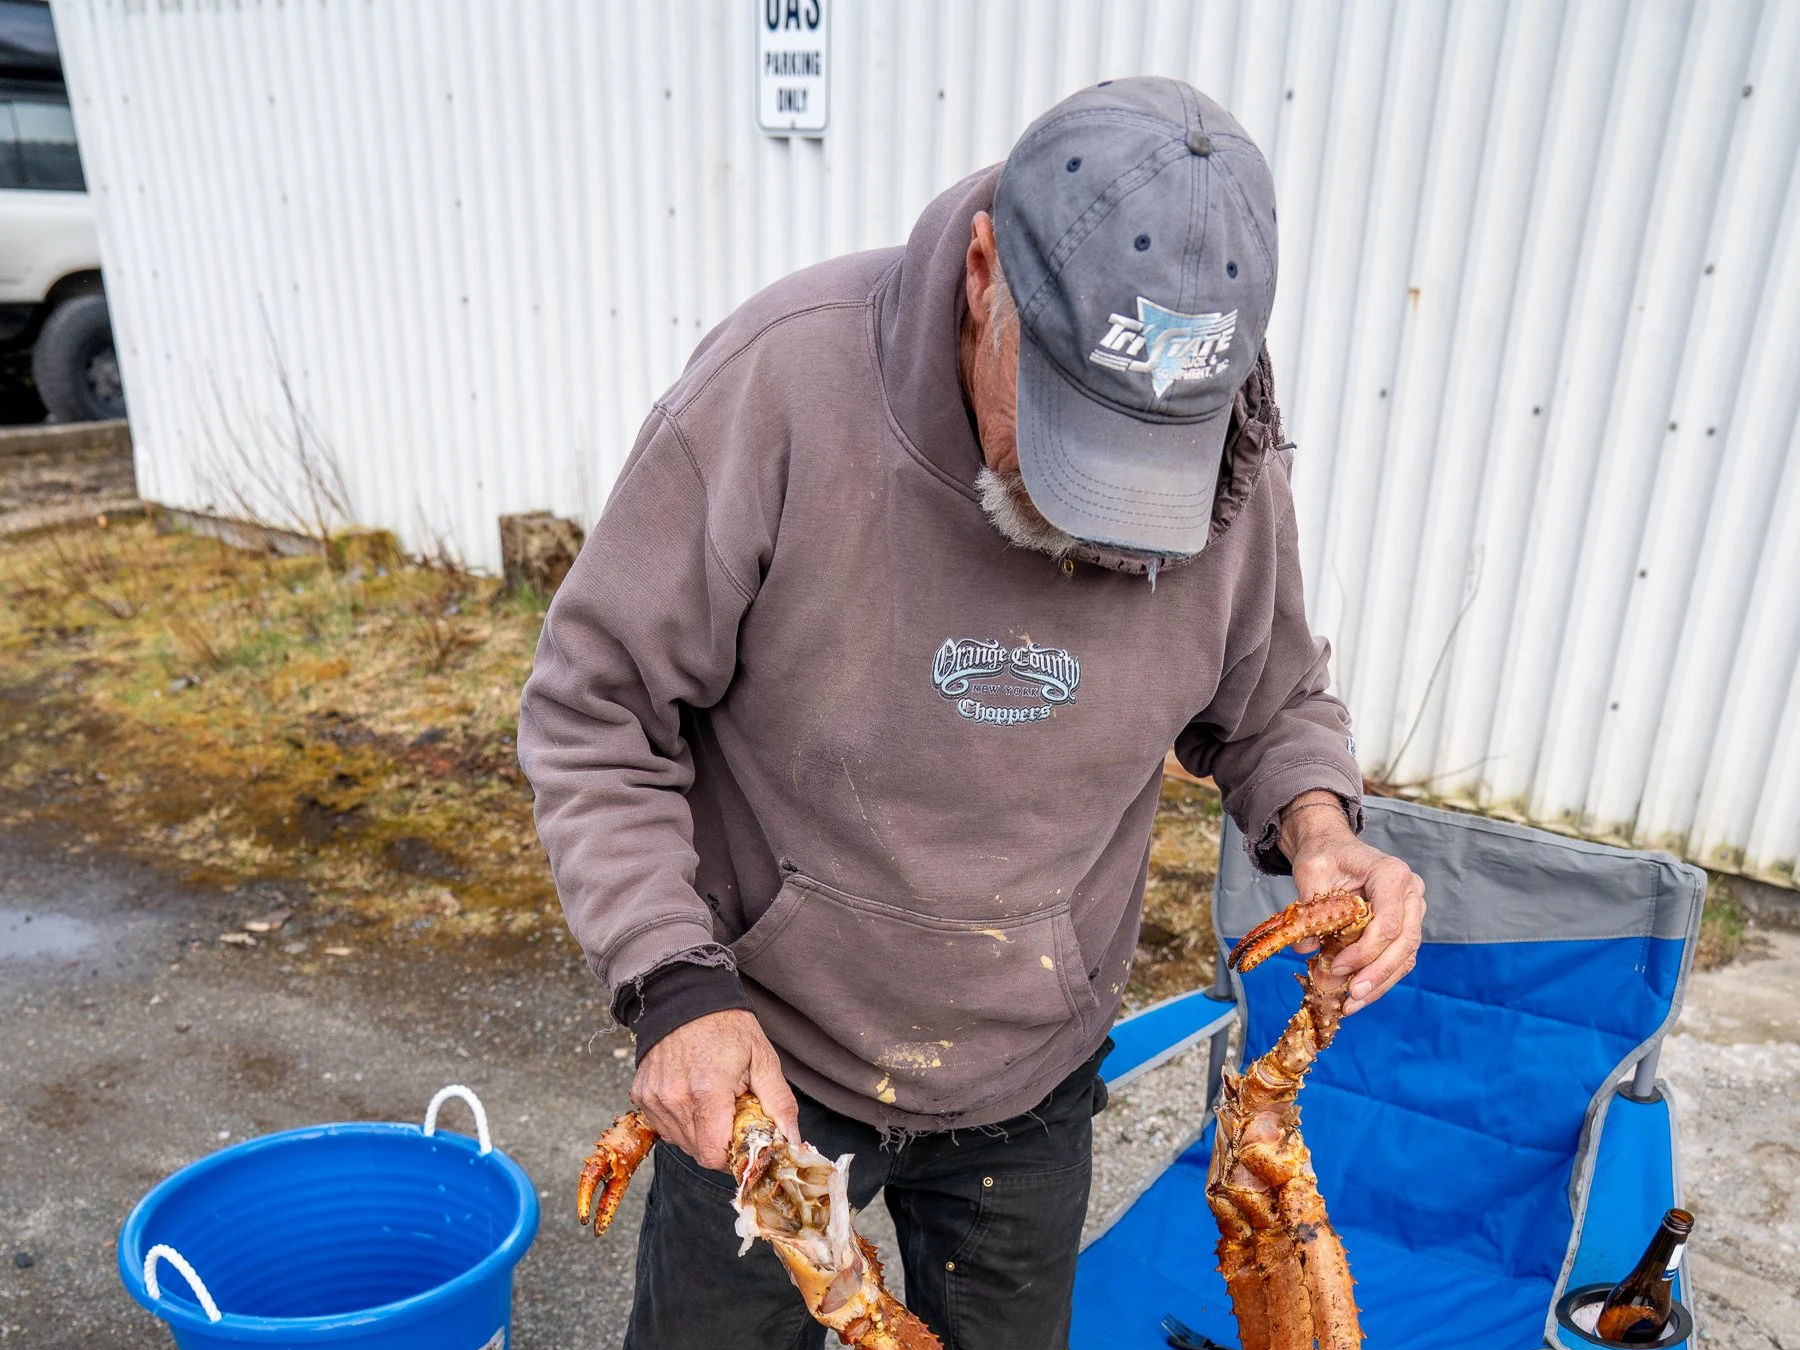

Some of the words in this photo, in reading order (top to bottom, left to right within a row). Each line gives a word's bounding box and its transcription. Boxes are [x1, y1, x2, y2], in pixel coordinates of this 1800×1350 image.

[764, 51, 821, 76] PARKING
[777, 87, 808, 113] ONLY
[932, 637, 1008, 688] Orange
[1010, 643, 1081, 699] County
[956, 698, 1052, 725] Choppers
